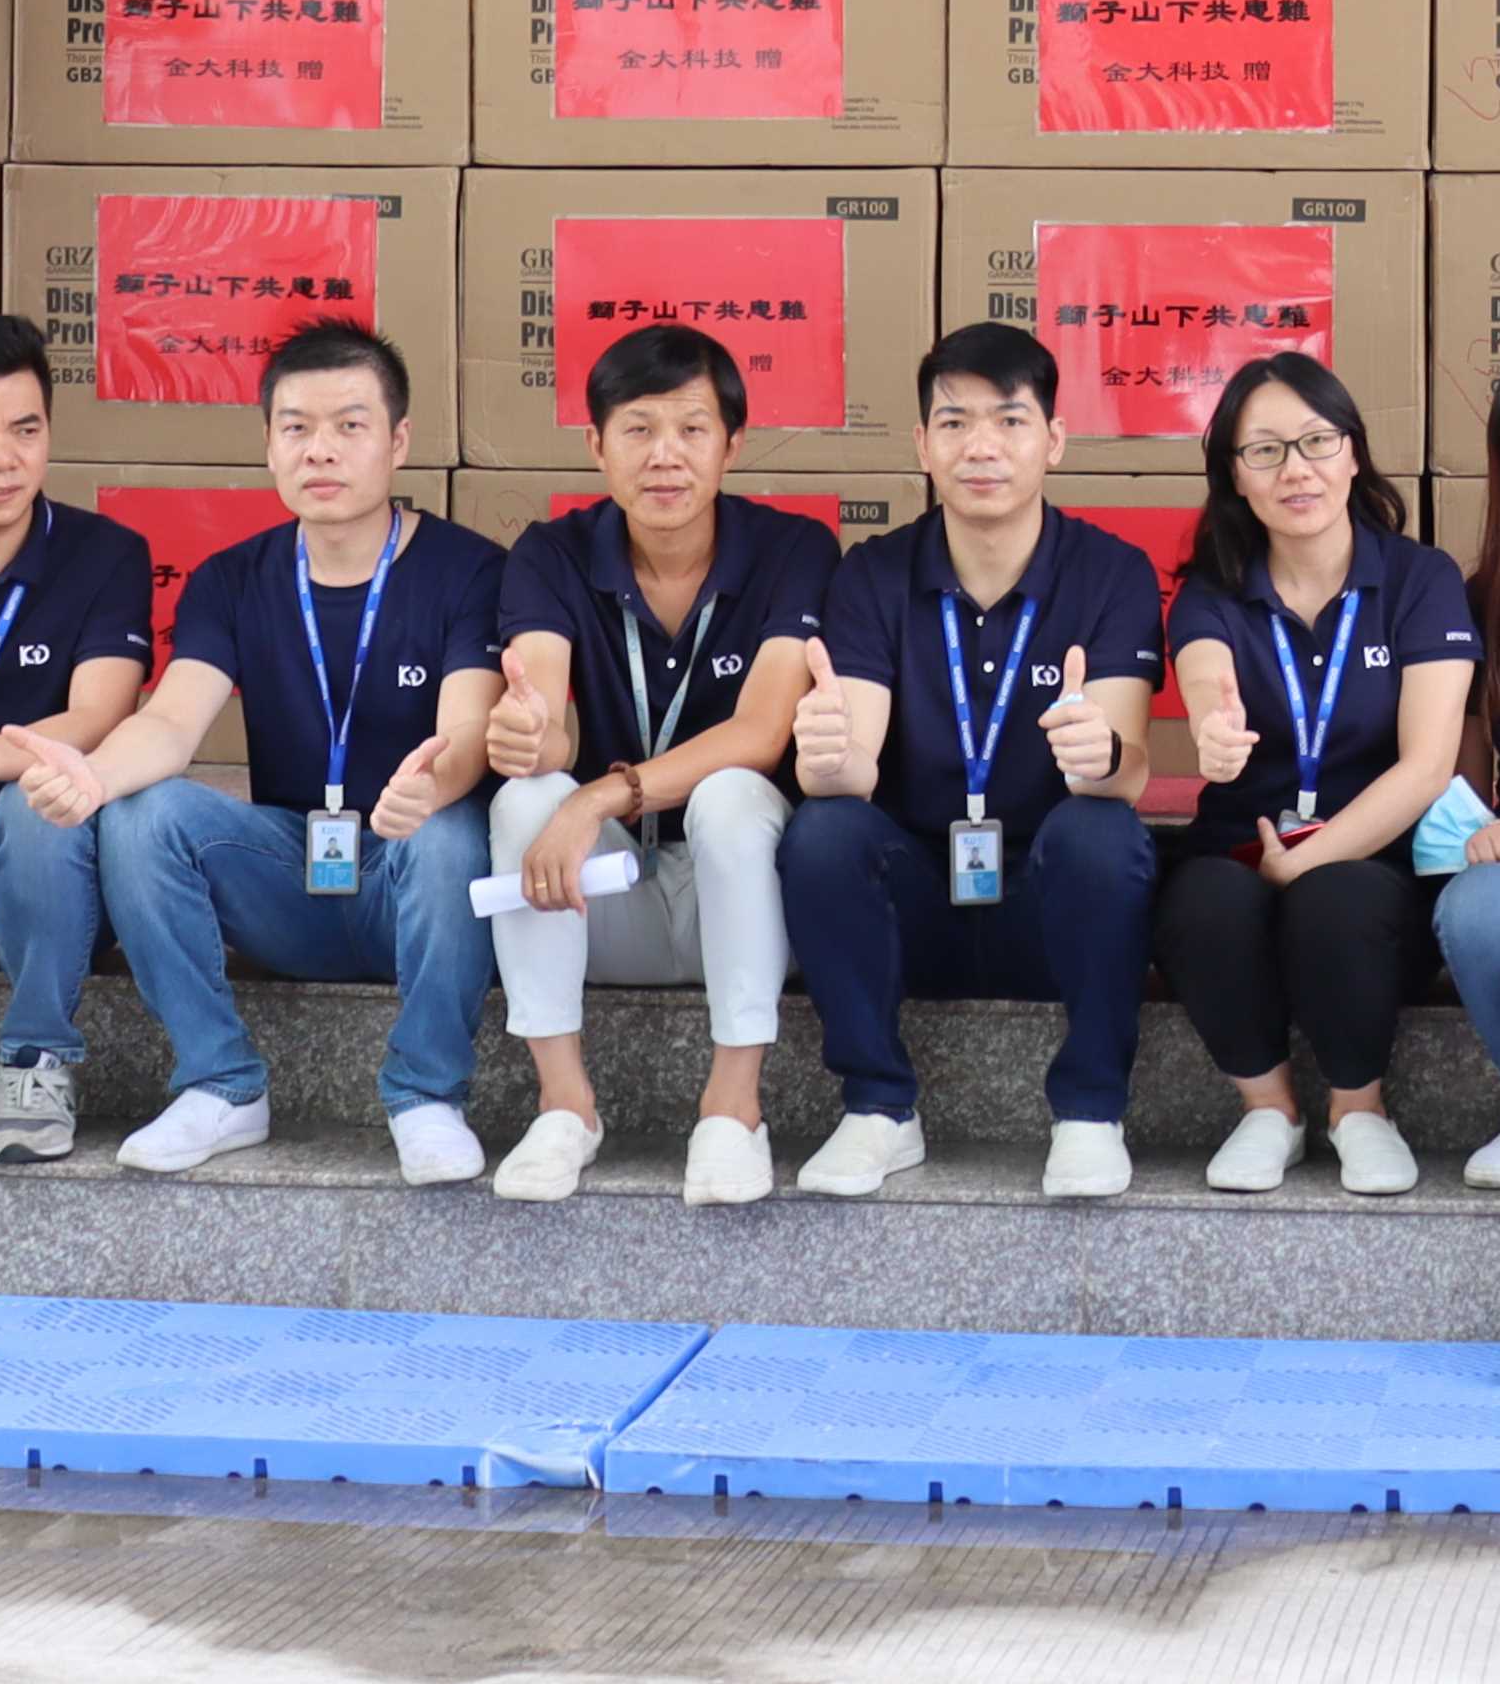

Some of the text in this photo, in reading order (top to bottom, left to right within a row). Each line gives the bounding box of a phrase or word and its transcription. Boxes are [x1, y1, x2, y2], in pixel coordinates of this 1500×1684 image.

[164, 57, 285, 80] 金大科技
[618, 49, 742, 70] 金大科技
[1102, 61, 1230, 83] 金大科技
[836, 201, 889, 216] GR100
[1302, 202, 1356, 218] GR100
[46, 246, 93, 267] GRZ
[839, 505, 880, 520] R100
